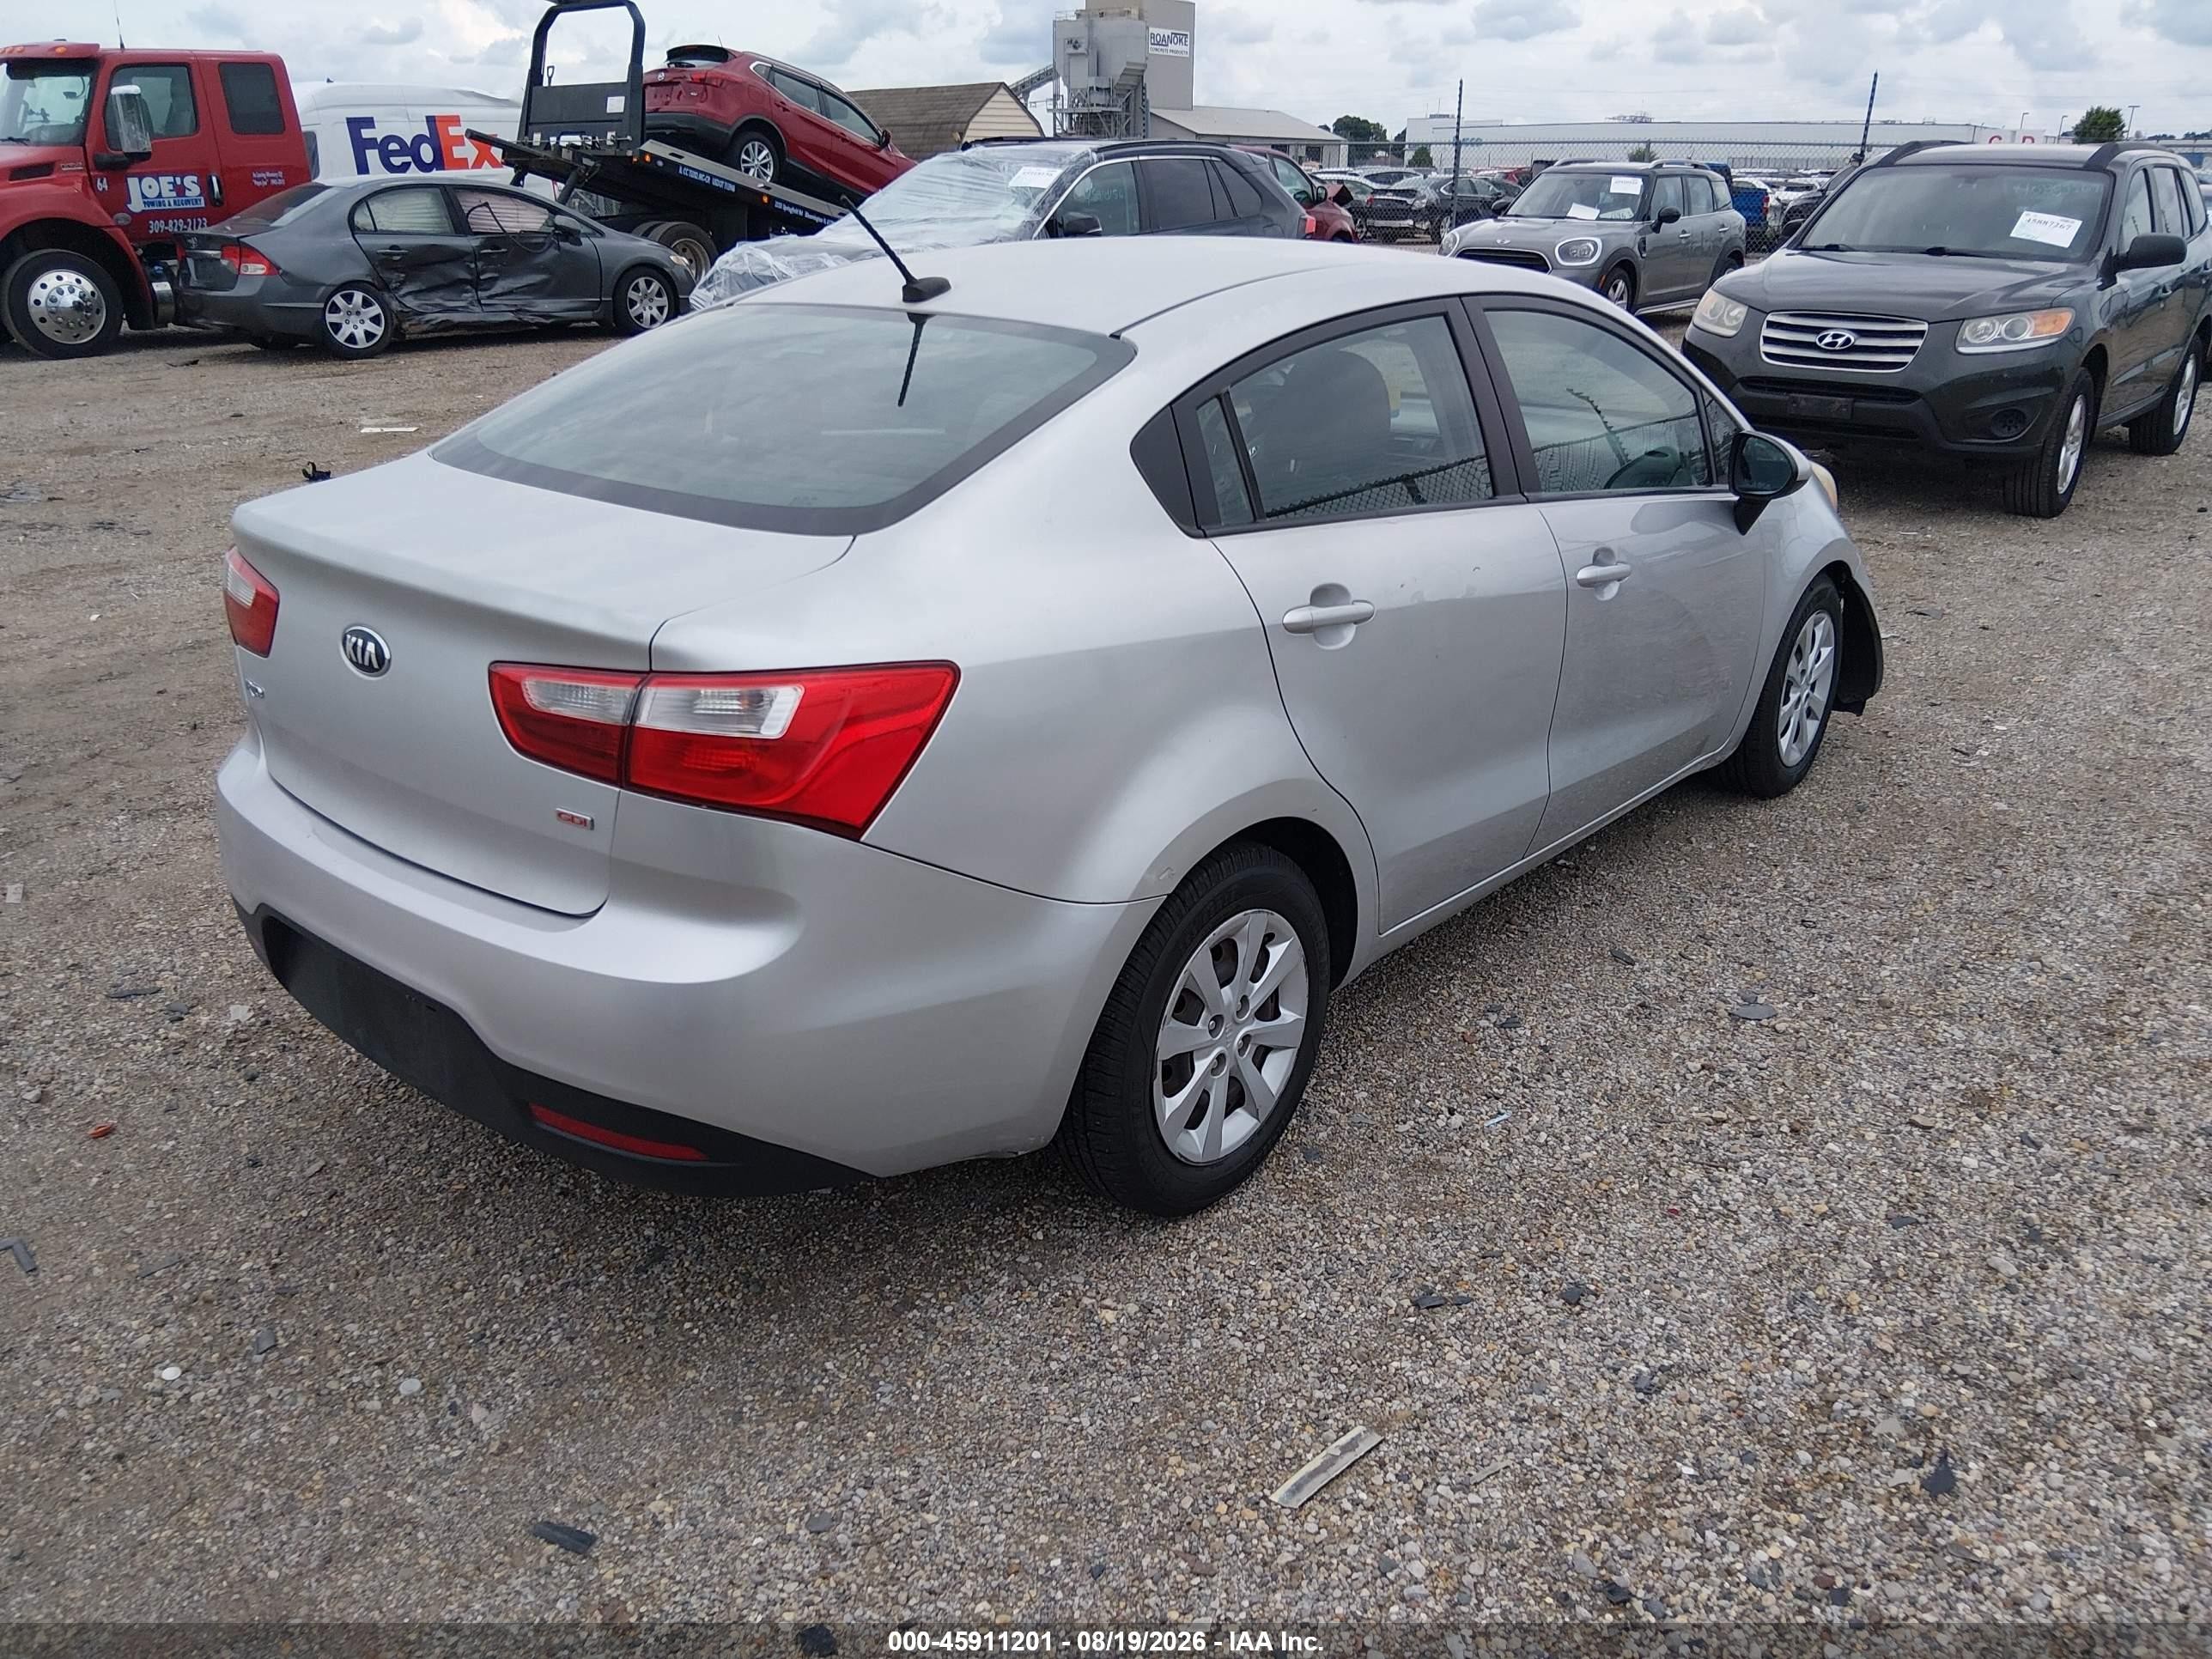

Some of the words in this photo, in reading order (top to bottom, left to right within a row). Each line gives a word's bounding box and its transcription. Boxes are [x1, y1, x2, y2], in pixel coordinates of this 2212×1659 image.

[1150, 33, 1188, 46] ROANOKE
[346, 115, 503, 175] FedEx
[96, 177, 108, 191] 64
[127, 175, 201, 213] JOE'S
[143, 199, 167, 208] TOWING
[173, 198, 203, 207] RECOVERY
[149, 216, 208, 234] 309-829-2123
[345, 634, 380, 669] KIA
